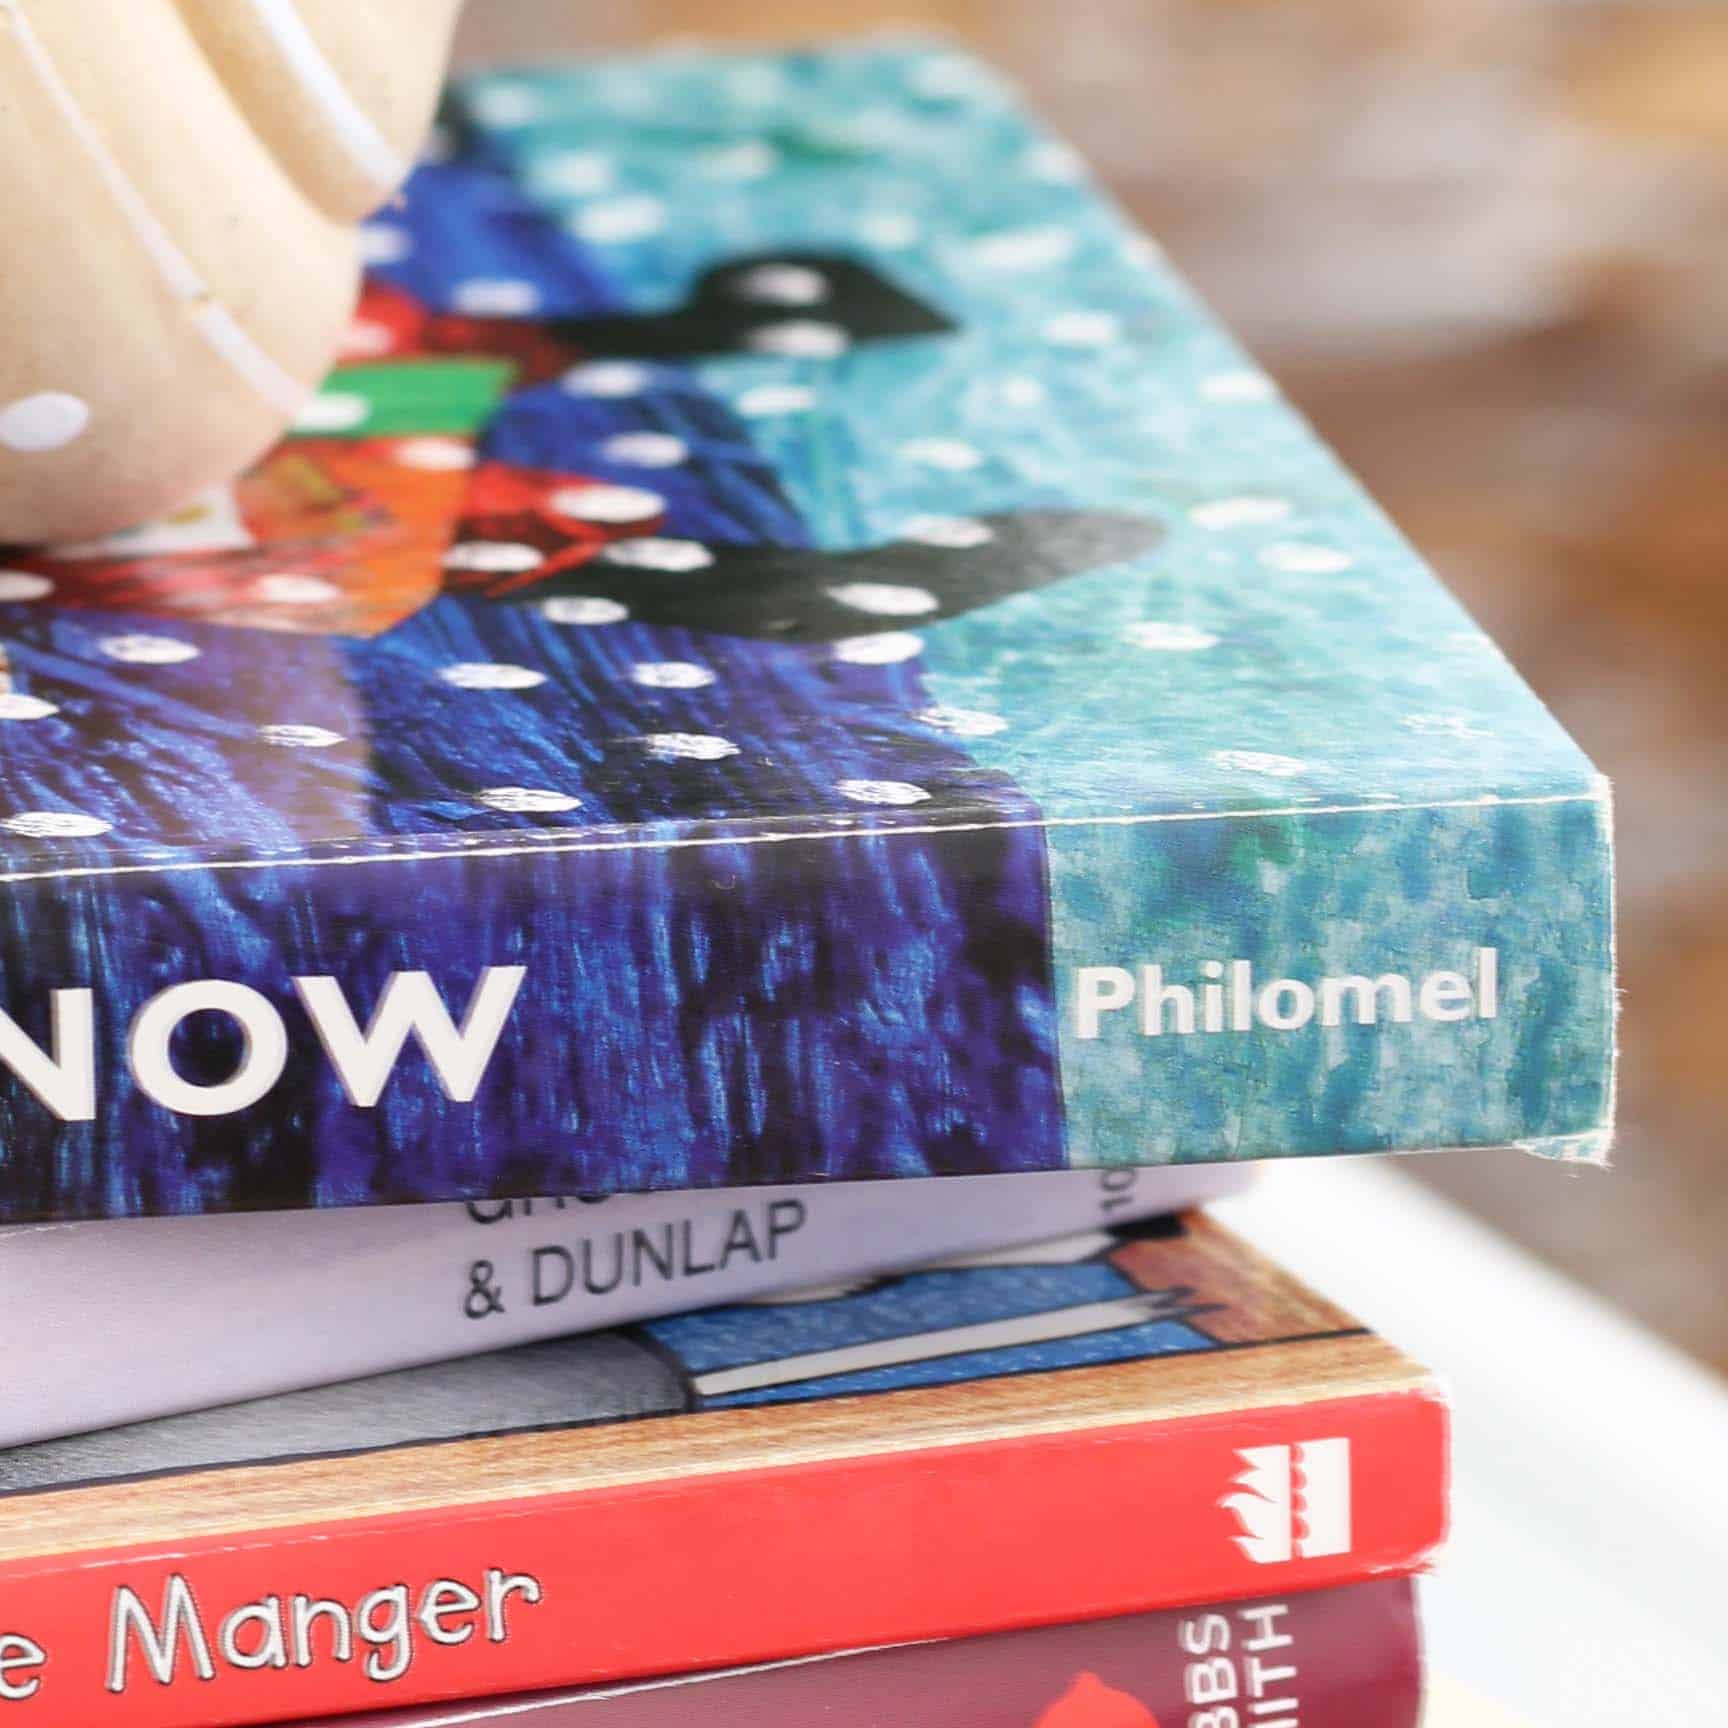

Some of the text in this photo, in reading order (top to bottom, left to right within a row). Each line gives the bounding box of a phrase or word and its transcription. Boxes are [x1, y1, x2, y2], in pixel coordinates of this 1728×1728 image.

[1074, 948, 1499, 1040] Philomel
[463, 1197, 808, 1320] & DUNLAP
[104, 1568, 542, 1692] Manger
